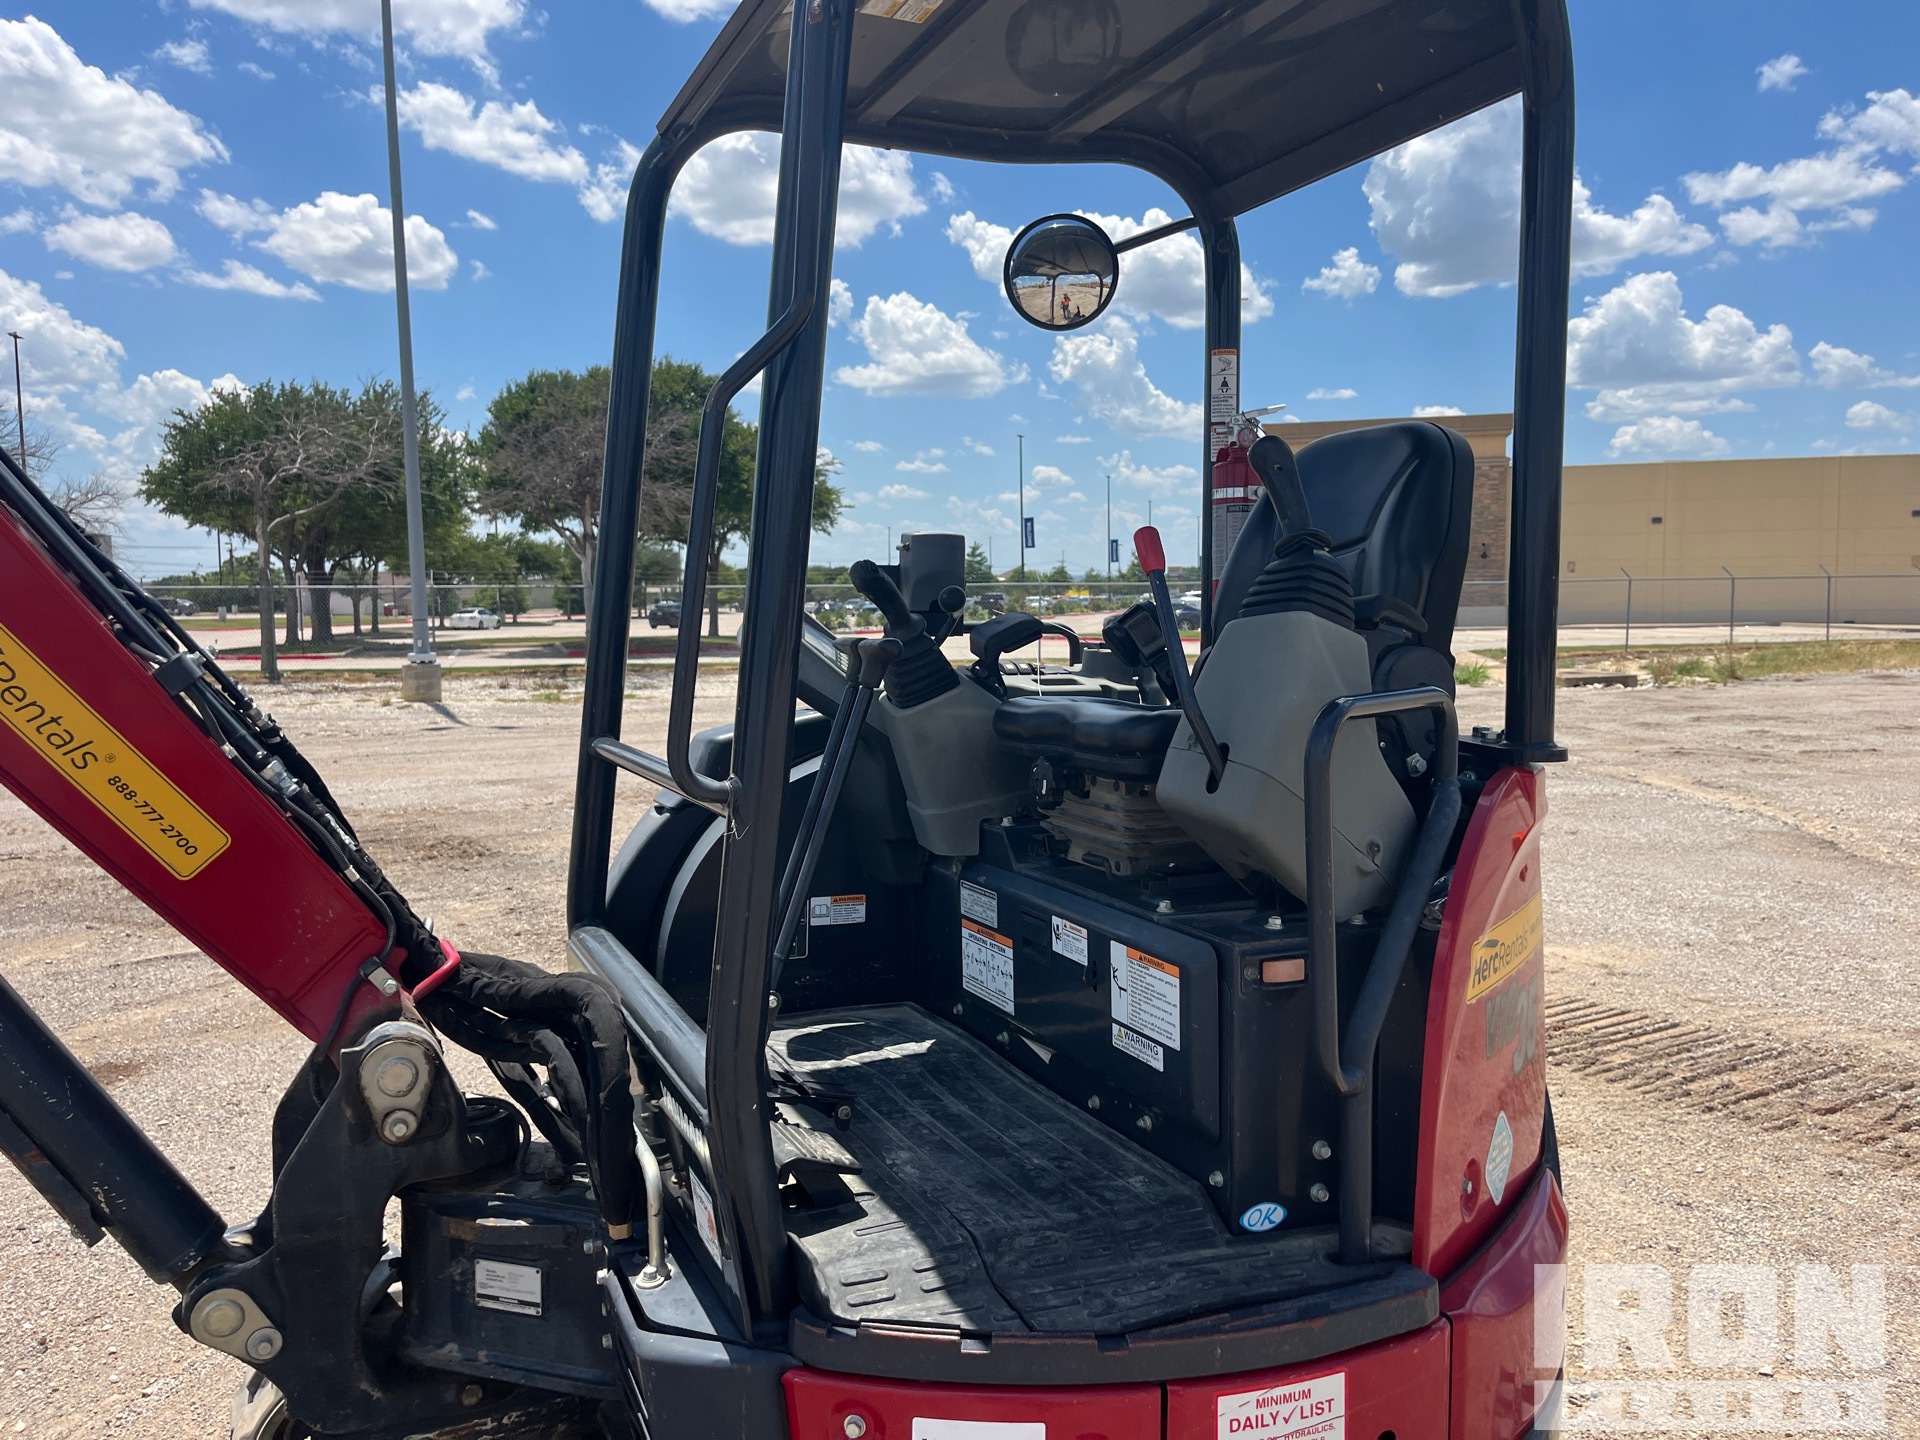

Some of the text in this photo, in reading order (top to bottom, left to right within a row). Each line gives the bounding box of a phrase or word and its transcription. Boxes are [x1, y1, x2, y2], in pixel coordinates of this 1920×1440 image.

[108, 775, 198, 855] 888-777-2700
[968, 932, 1006, 954] OPERATING PATTERN
[1142, 954, 1164, 970] WARNING
[1123, 1029, 1158, 1056] WARNING
[1248, 1206, 1277, 1227] OK
[1255, 1388, 1312, 1409] MINIMUM
[1229, 1399, 1335, 1433] DAILY LIST
